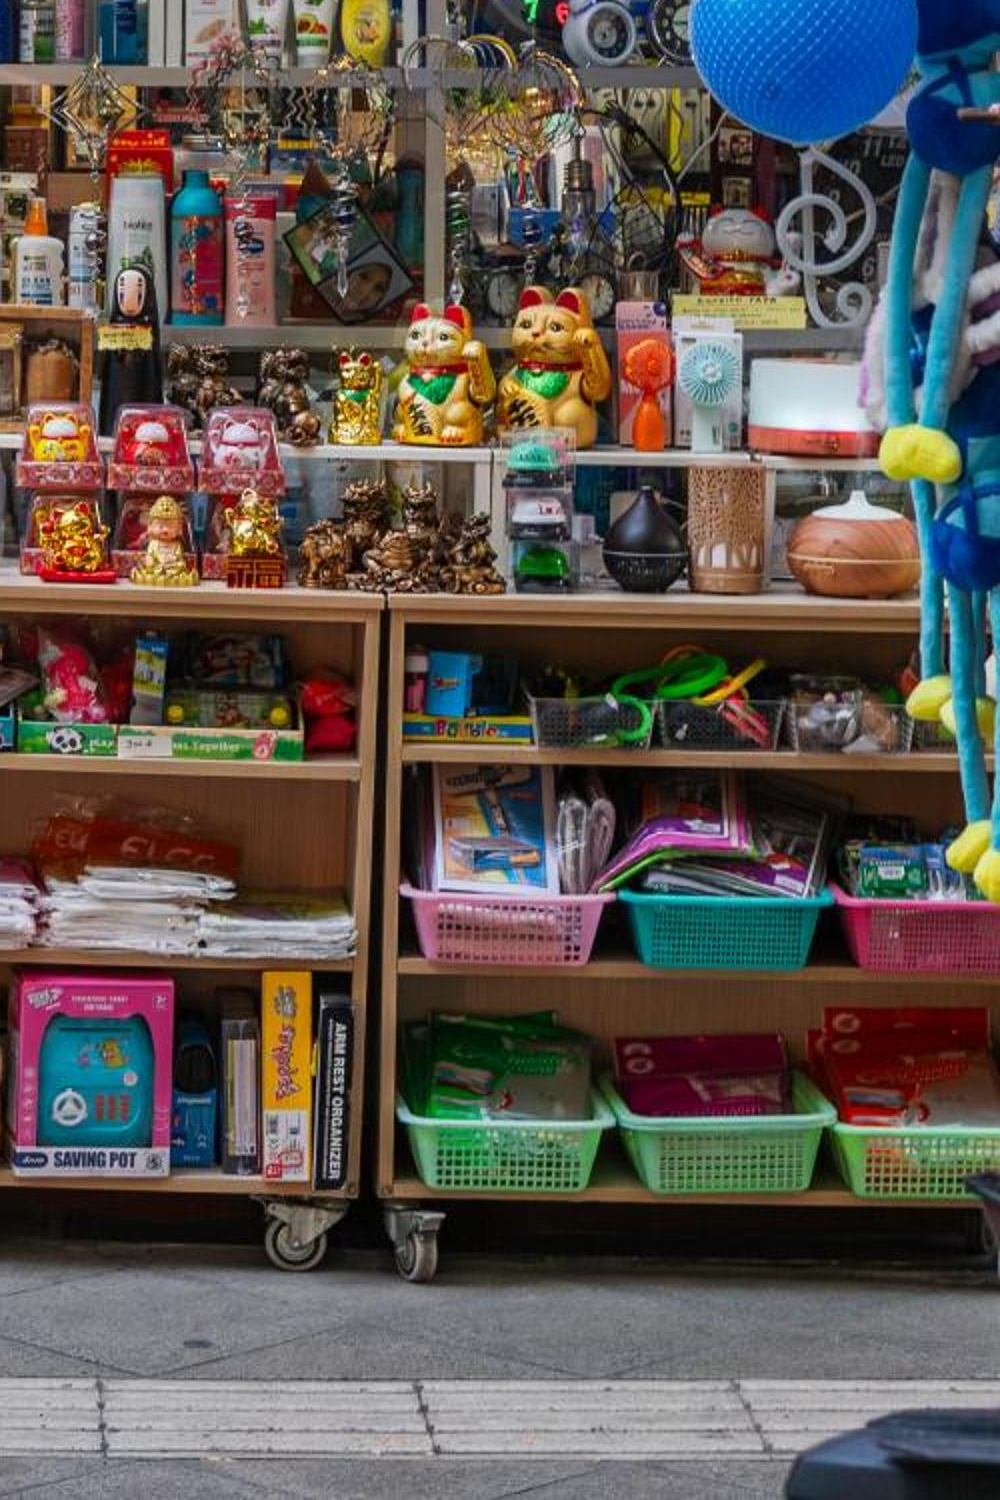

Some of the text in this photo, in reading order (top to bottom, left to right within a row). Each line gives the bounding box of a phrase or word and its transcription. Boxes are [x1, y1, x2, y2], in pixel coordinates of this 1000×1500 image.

[328, 1022, 347, 1181] ARM REST ORGANIZER
[53, 1151, 104, 1169] SAVING
[108, 1151, 138, 1169] POT
